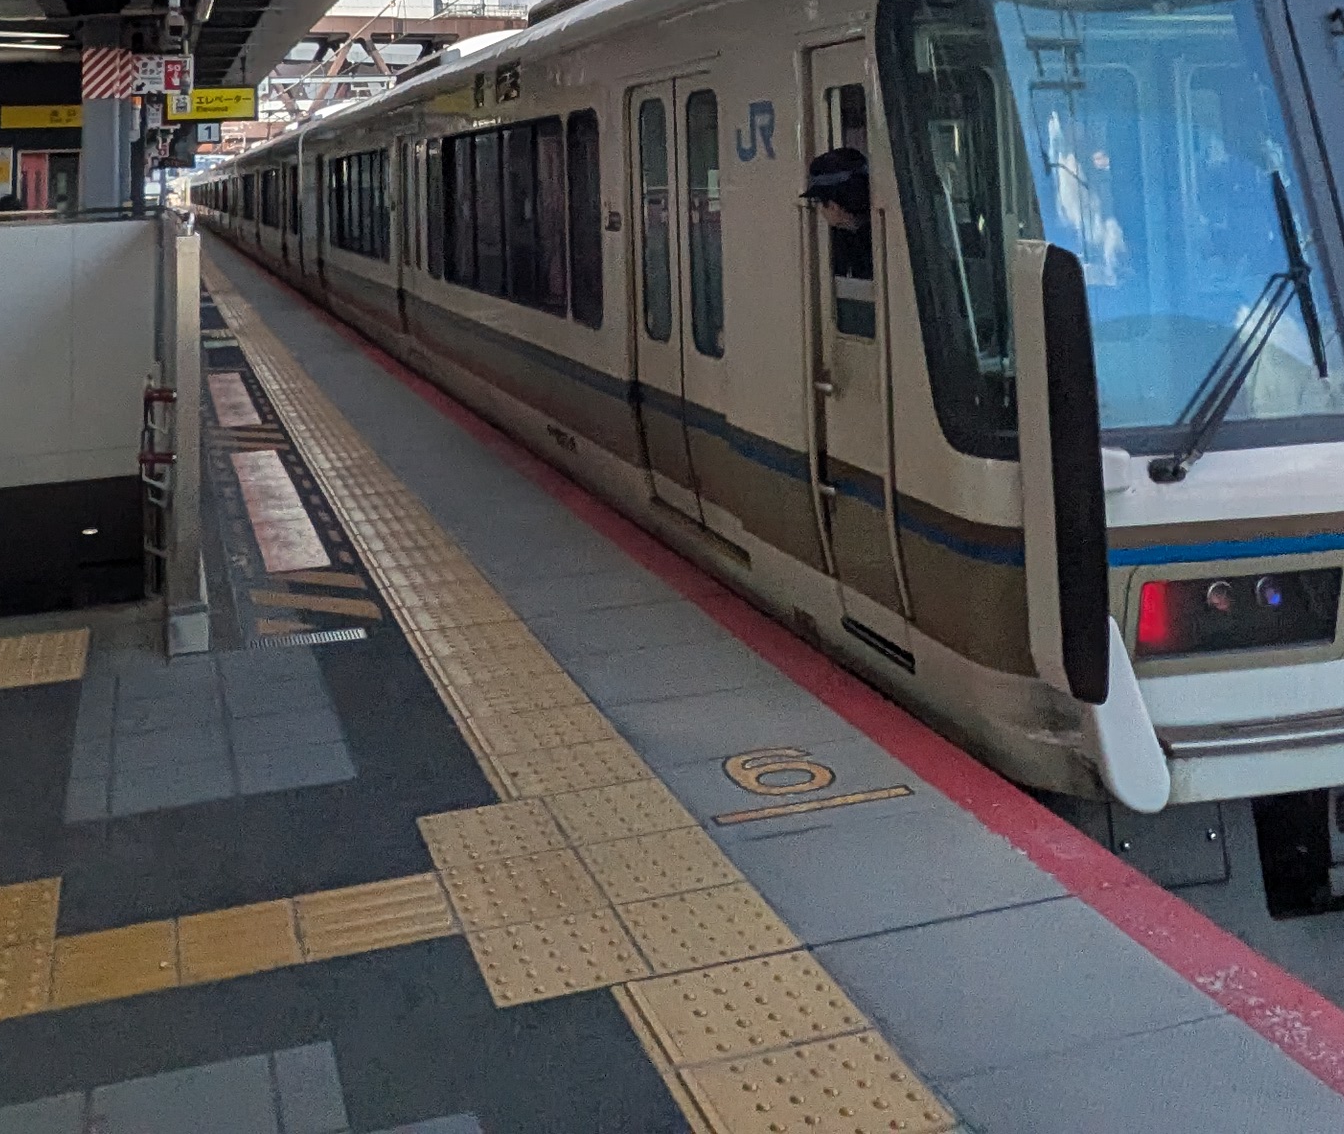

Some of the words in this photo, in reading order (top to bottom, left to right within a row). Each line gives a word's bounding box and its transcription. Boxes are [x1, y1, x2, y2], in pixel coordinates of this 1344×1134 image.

[196, 95, 252, 105] エレベーター
[203, 126, 212, 140] 1
[735, 100, 776, 162] JR
